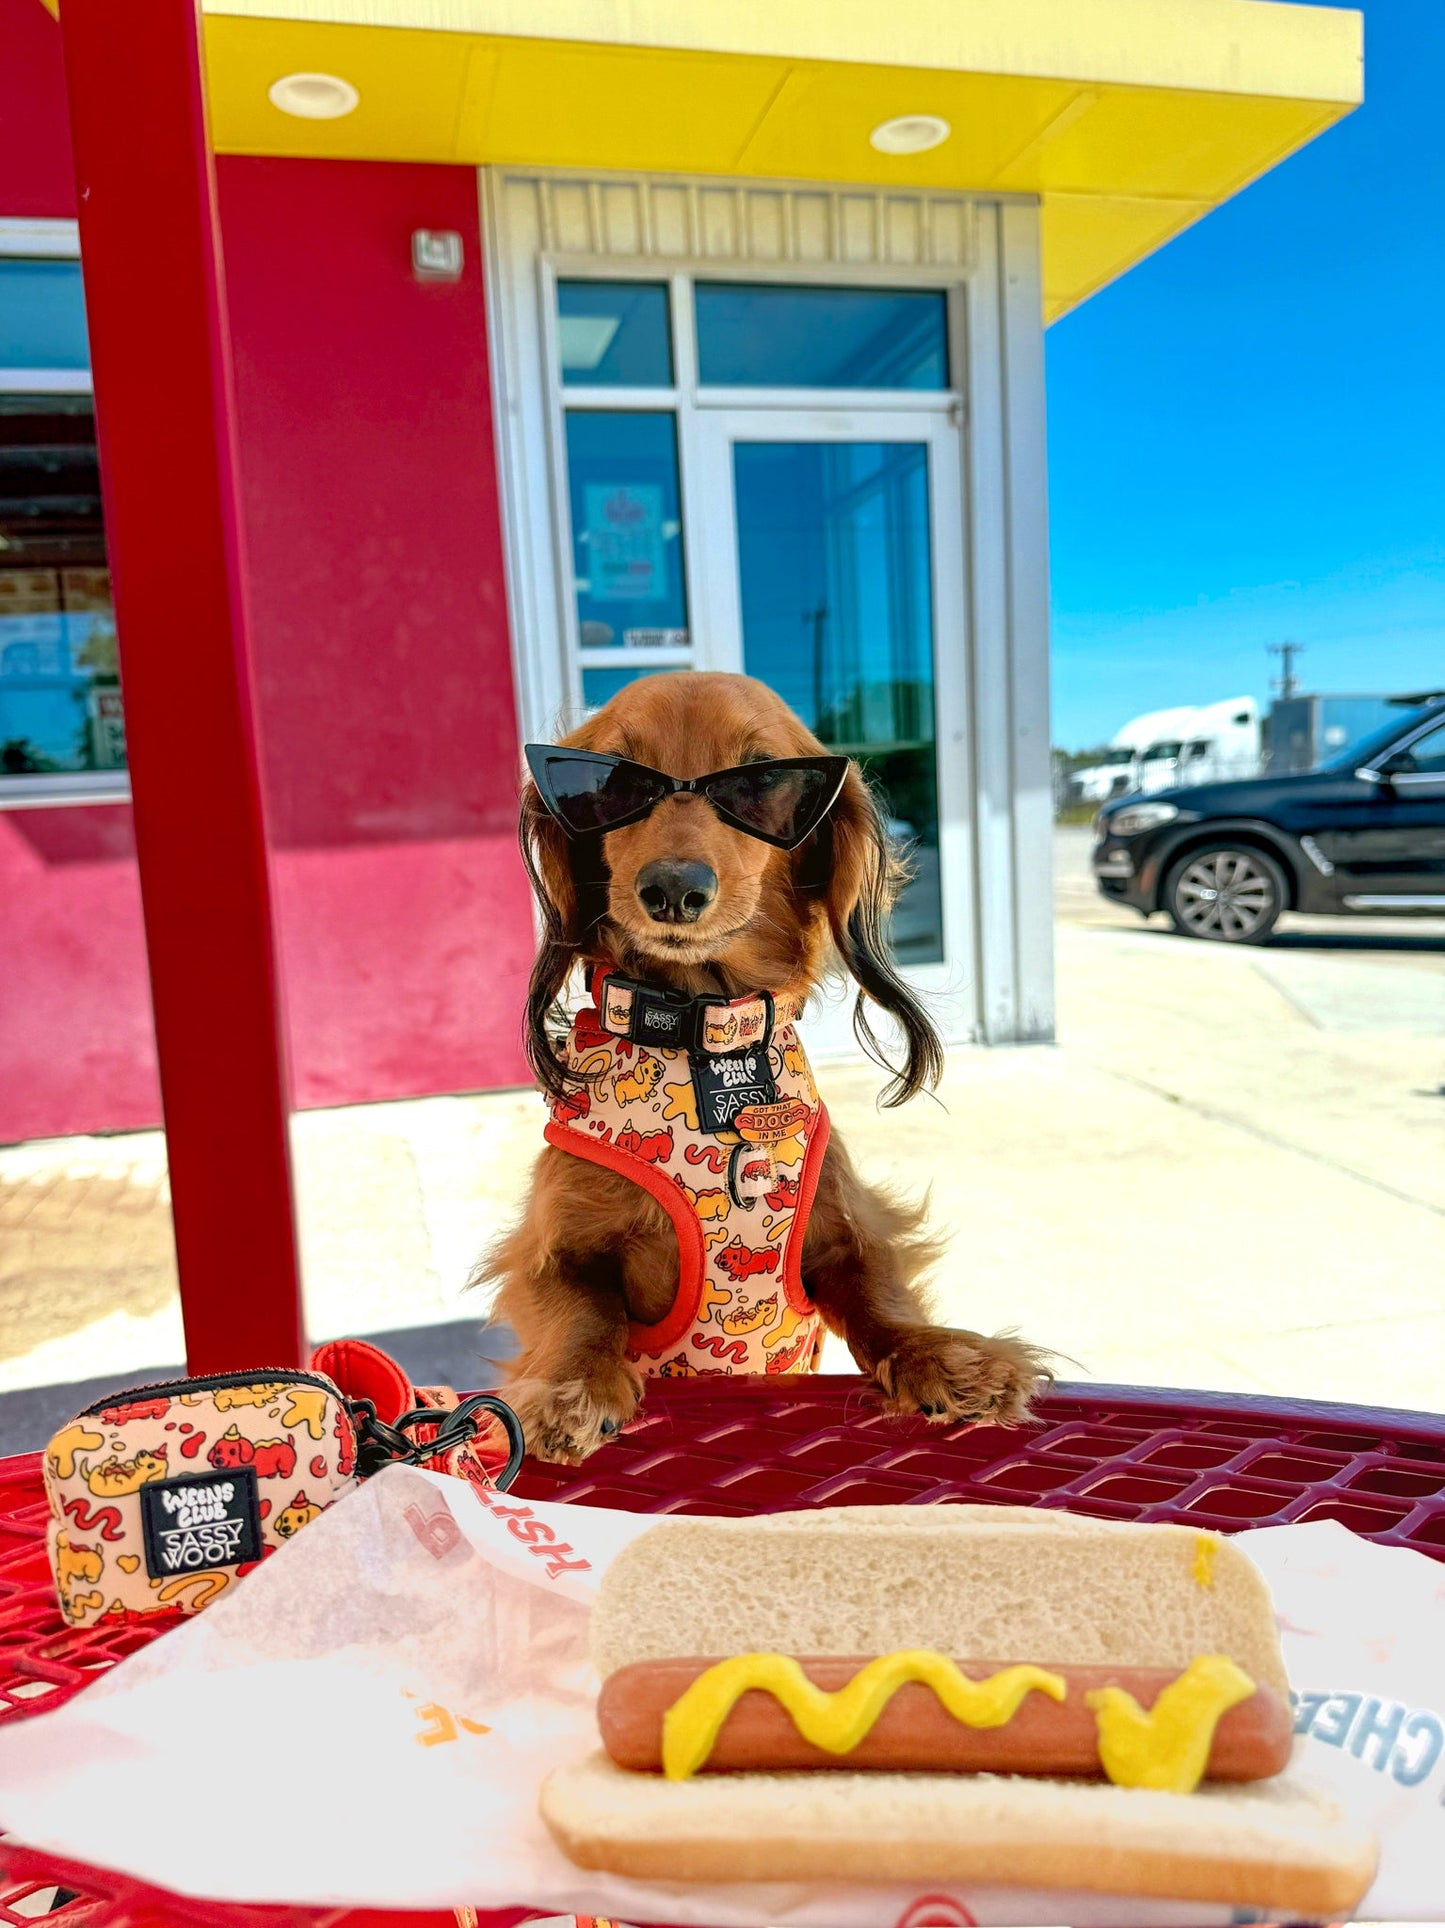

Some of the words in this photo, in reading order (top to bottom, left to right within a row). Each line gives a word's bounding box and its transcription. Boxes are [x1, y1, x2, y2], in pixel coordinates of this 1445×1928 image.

[645, 1012, 675, 1031] WOOF
[647, 1010, 678, 1023] SASSY
[715, 1090, 766, 1110] SASSY
[770, 1102, 792, 1112] THAT
[753, 1112, 792, 1129] DOG
[758, 1131, 769, 1140] IN
[772, 1129, 787, 1139] ME
[161, 1482, 235, 1514] WEENS
[177, 1502, 228, 1528] CLUB
[165, 1523, 244, 1552] SASSY
[161, 1540, 241, 1569] WOOF
